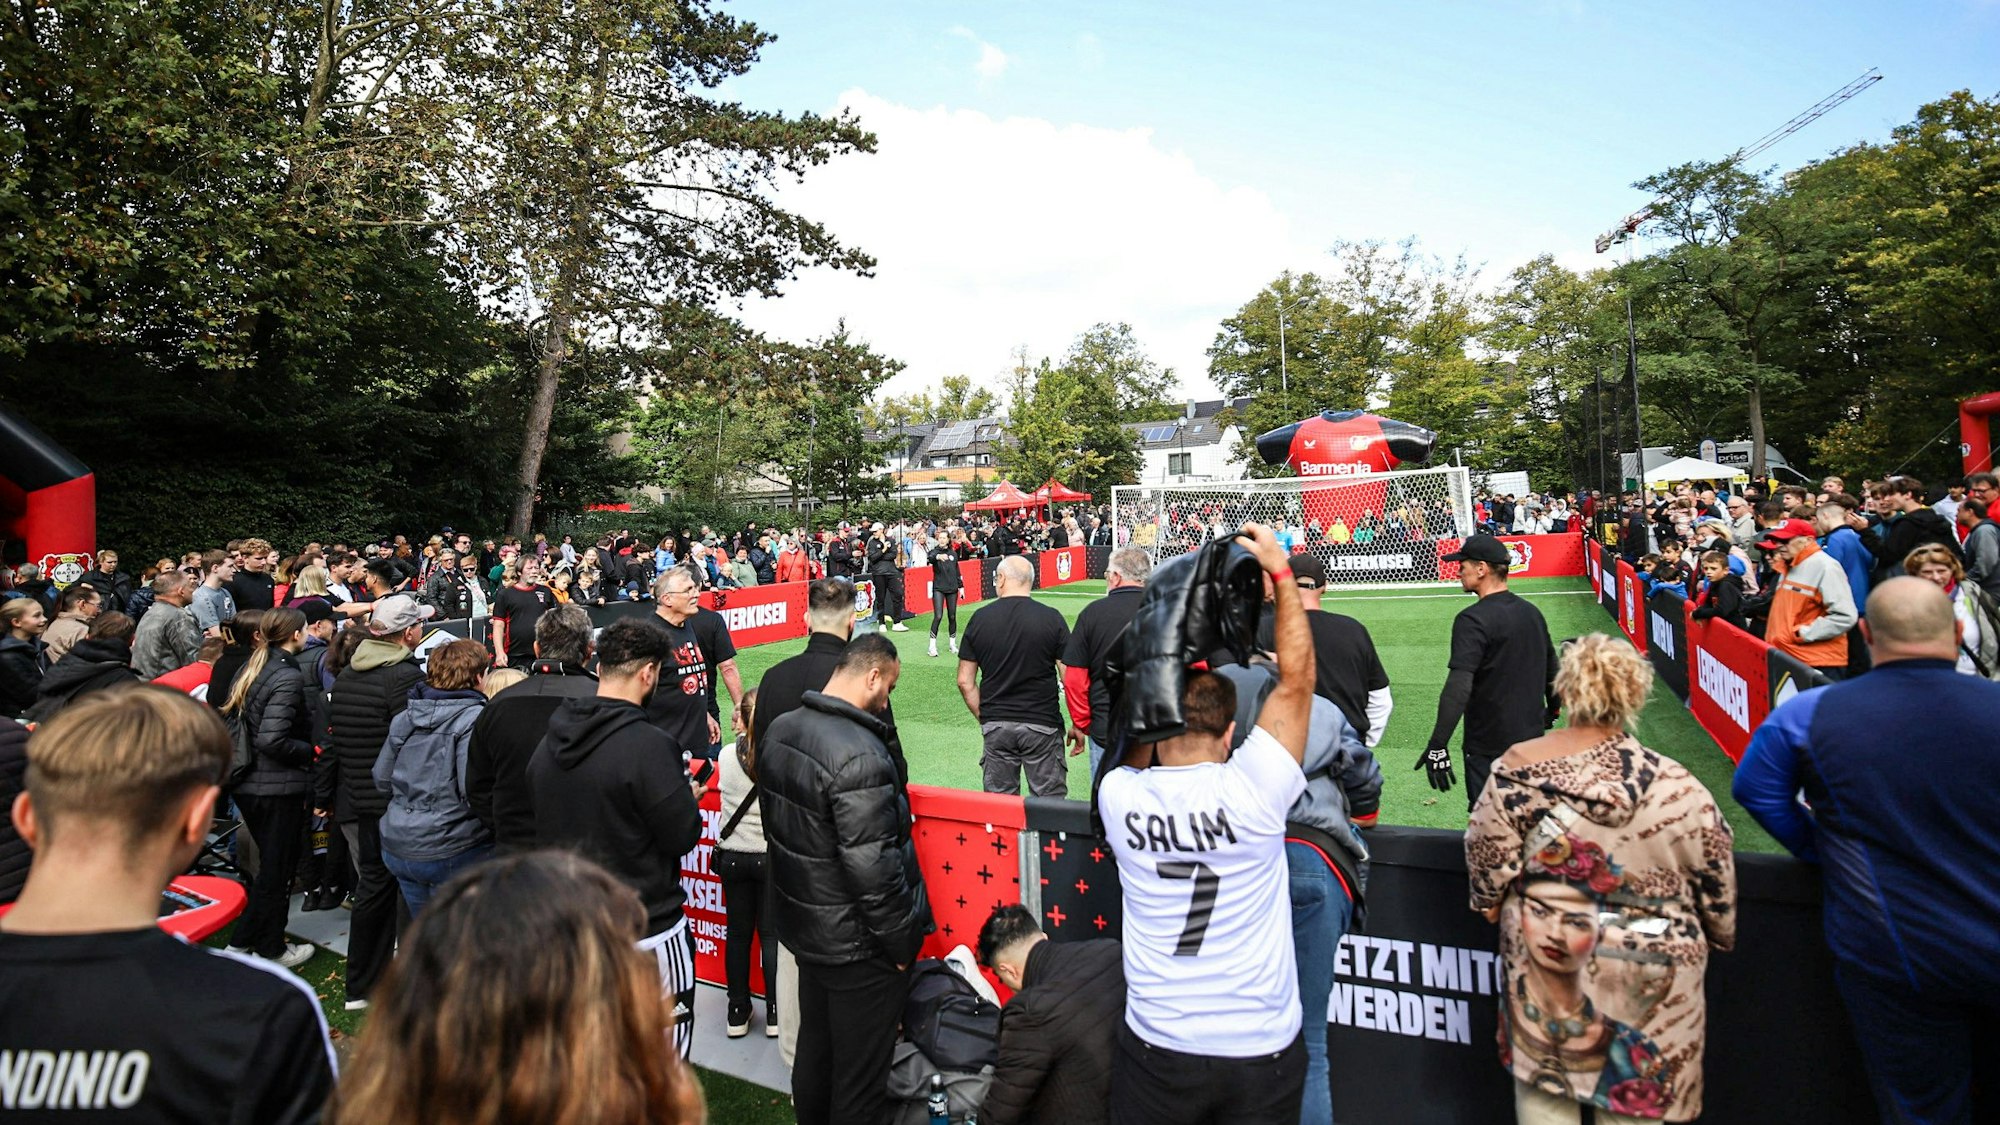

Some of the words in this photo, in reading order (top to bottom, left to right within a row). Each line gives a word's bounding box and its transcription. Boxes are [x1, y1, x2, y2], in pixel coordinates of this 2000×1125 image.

[1300, 460, 1372, 476] Barmenia
[1329, 554, 1413, 571] LEVERKUSEN
[716, 601, 787, 632] VERKUSEN
[1696, 644, 1751, 734] LEVERKUSEN
[1433, 760, 1451, 770] FOX
[1125, 808, 1238, 853] SALIM
[679, 876, 727, 914] KSEL
[1156, 861, 1220, 957] 7
